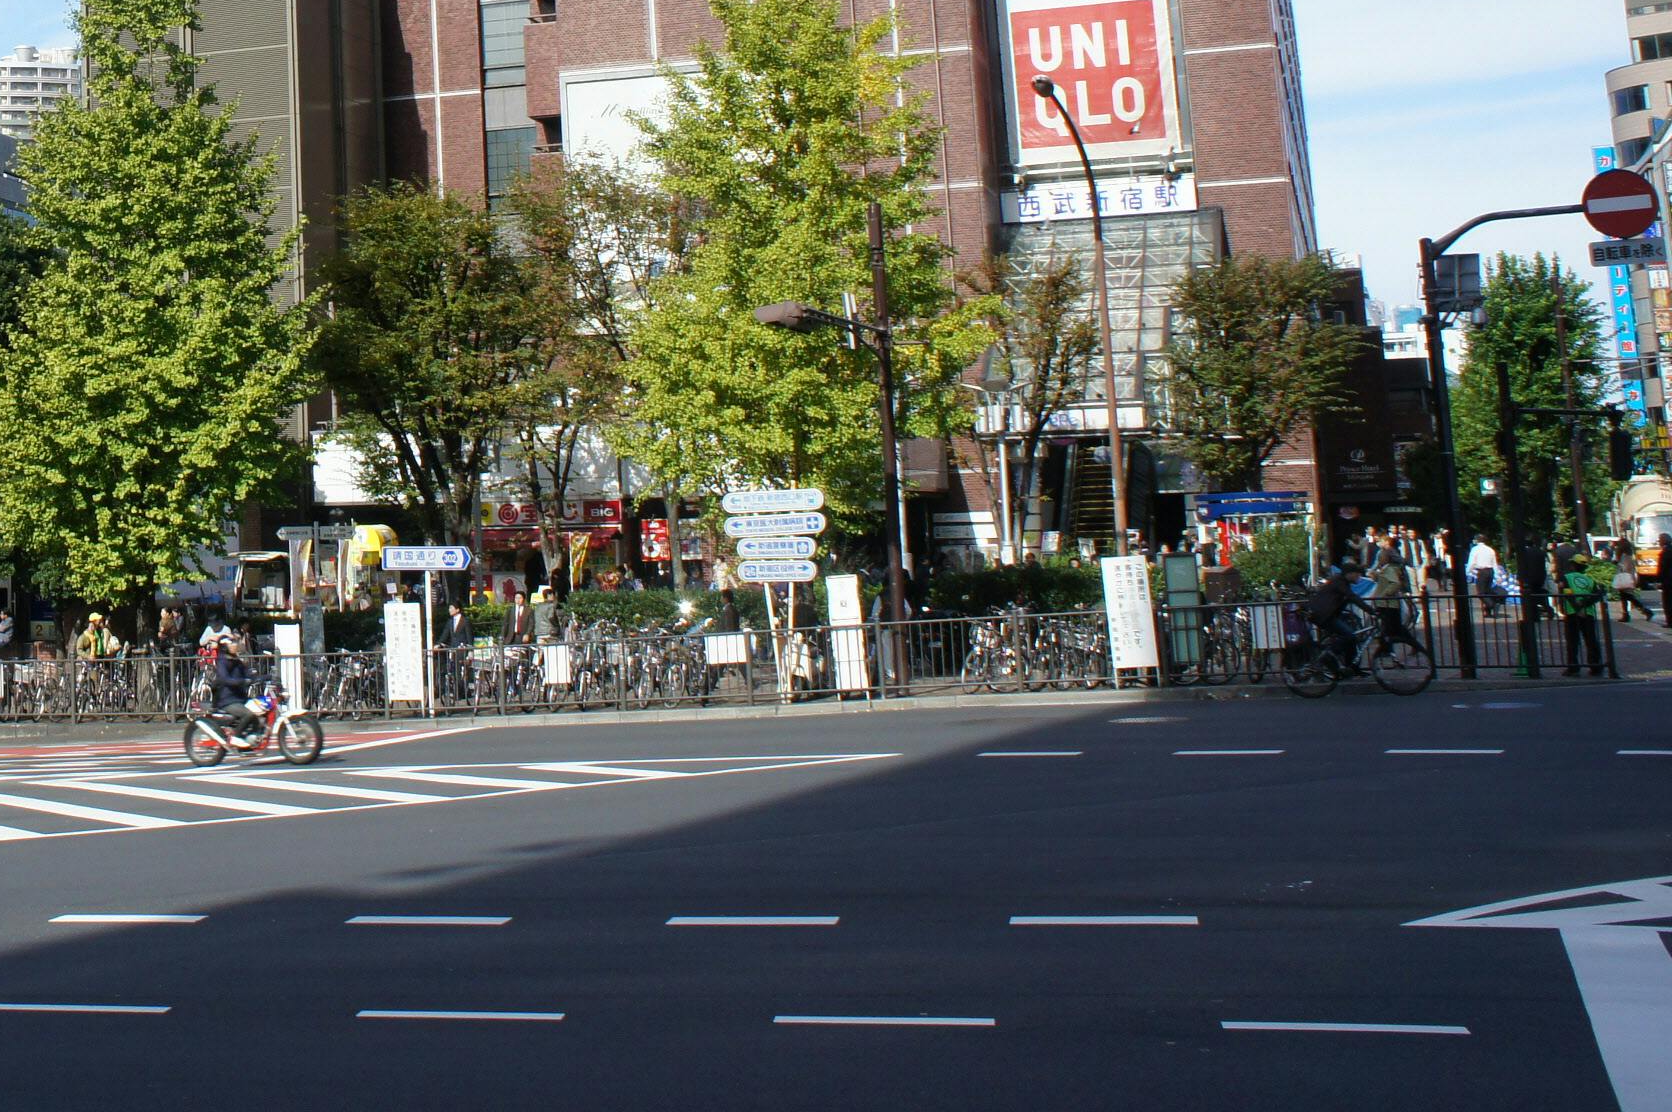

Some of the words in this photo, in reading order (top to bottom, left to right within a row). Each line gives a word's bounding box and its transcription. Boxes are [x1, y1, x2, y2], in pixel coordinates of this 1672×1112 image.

[1027, 18, 1130, 73] UNI
[1033, 77, 1147, 138] QLO
[1017, 184, 1179, 218] 西武新宿駅
[1593, 242, 1664, 262] 自転車を除く
[392, 550, 437, 561] 靖国通り
[443, 552, 458, 564] 302
[35, 624, 43, 637] 2
